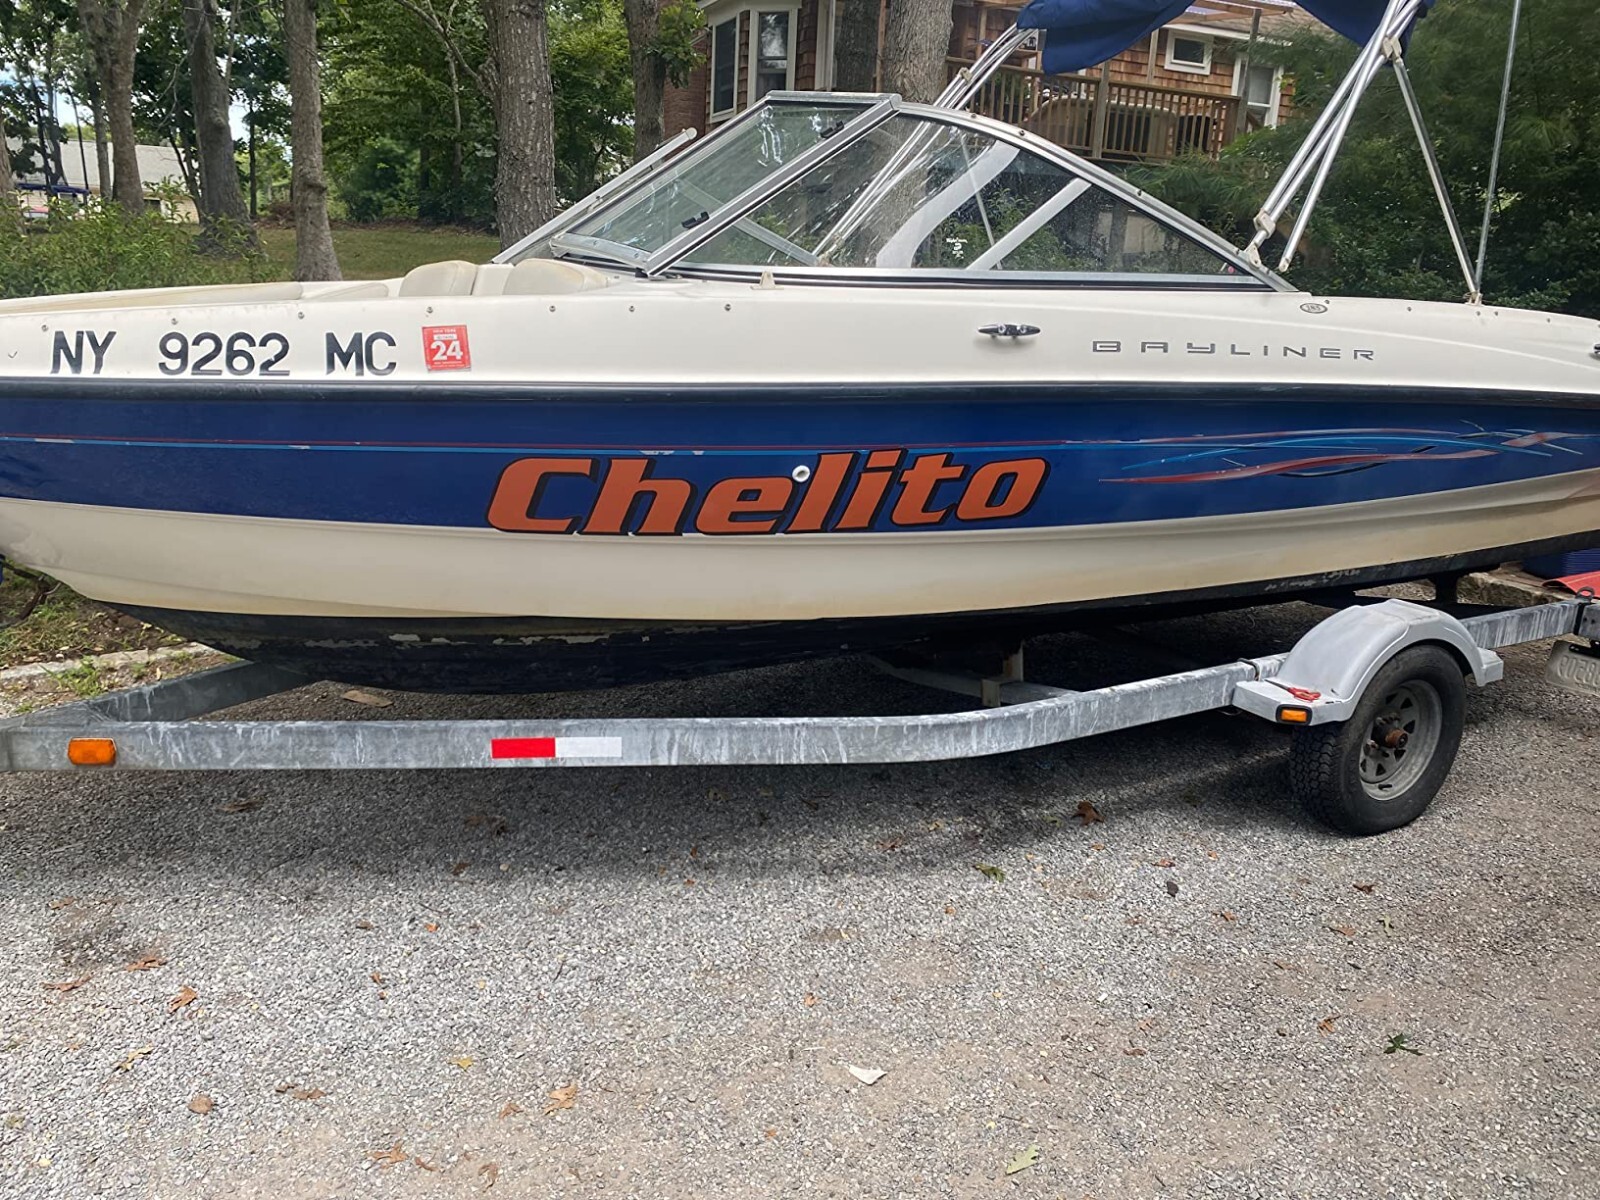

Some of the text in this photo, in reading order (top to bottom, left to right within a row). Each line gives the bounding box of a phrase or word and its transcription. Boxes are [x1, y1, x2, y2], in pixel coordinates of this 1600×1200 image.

[51, 331, 397, 376] NY 9262 MC
[431, 340, 463, 360] 24
[1092, 340, 1374, 361] BAYLINER
[486, 448, 1049, 535] Chelito
